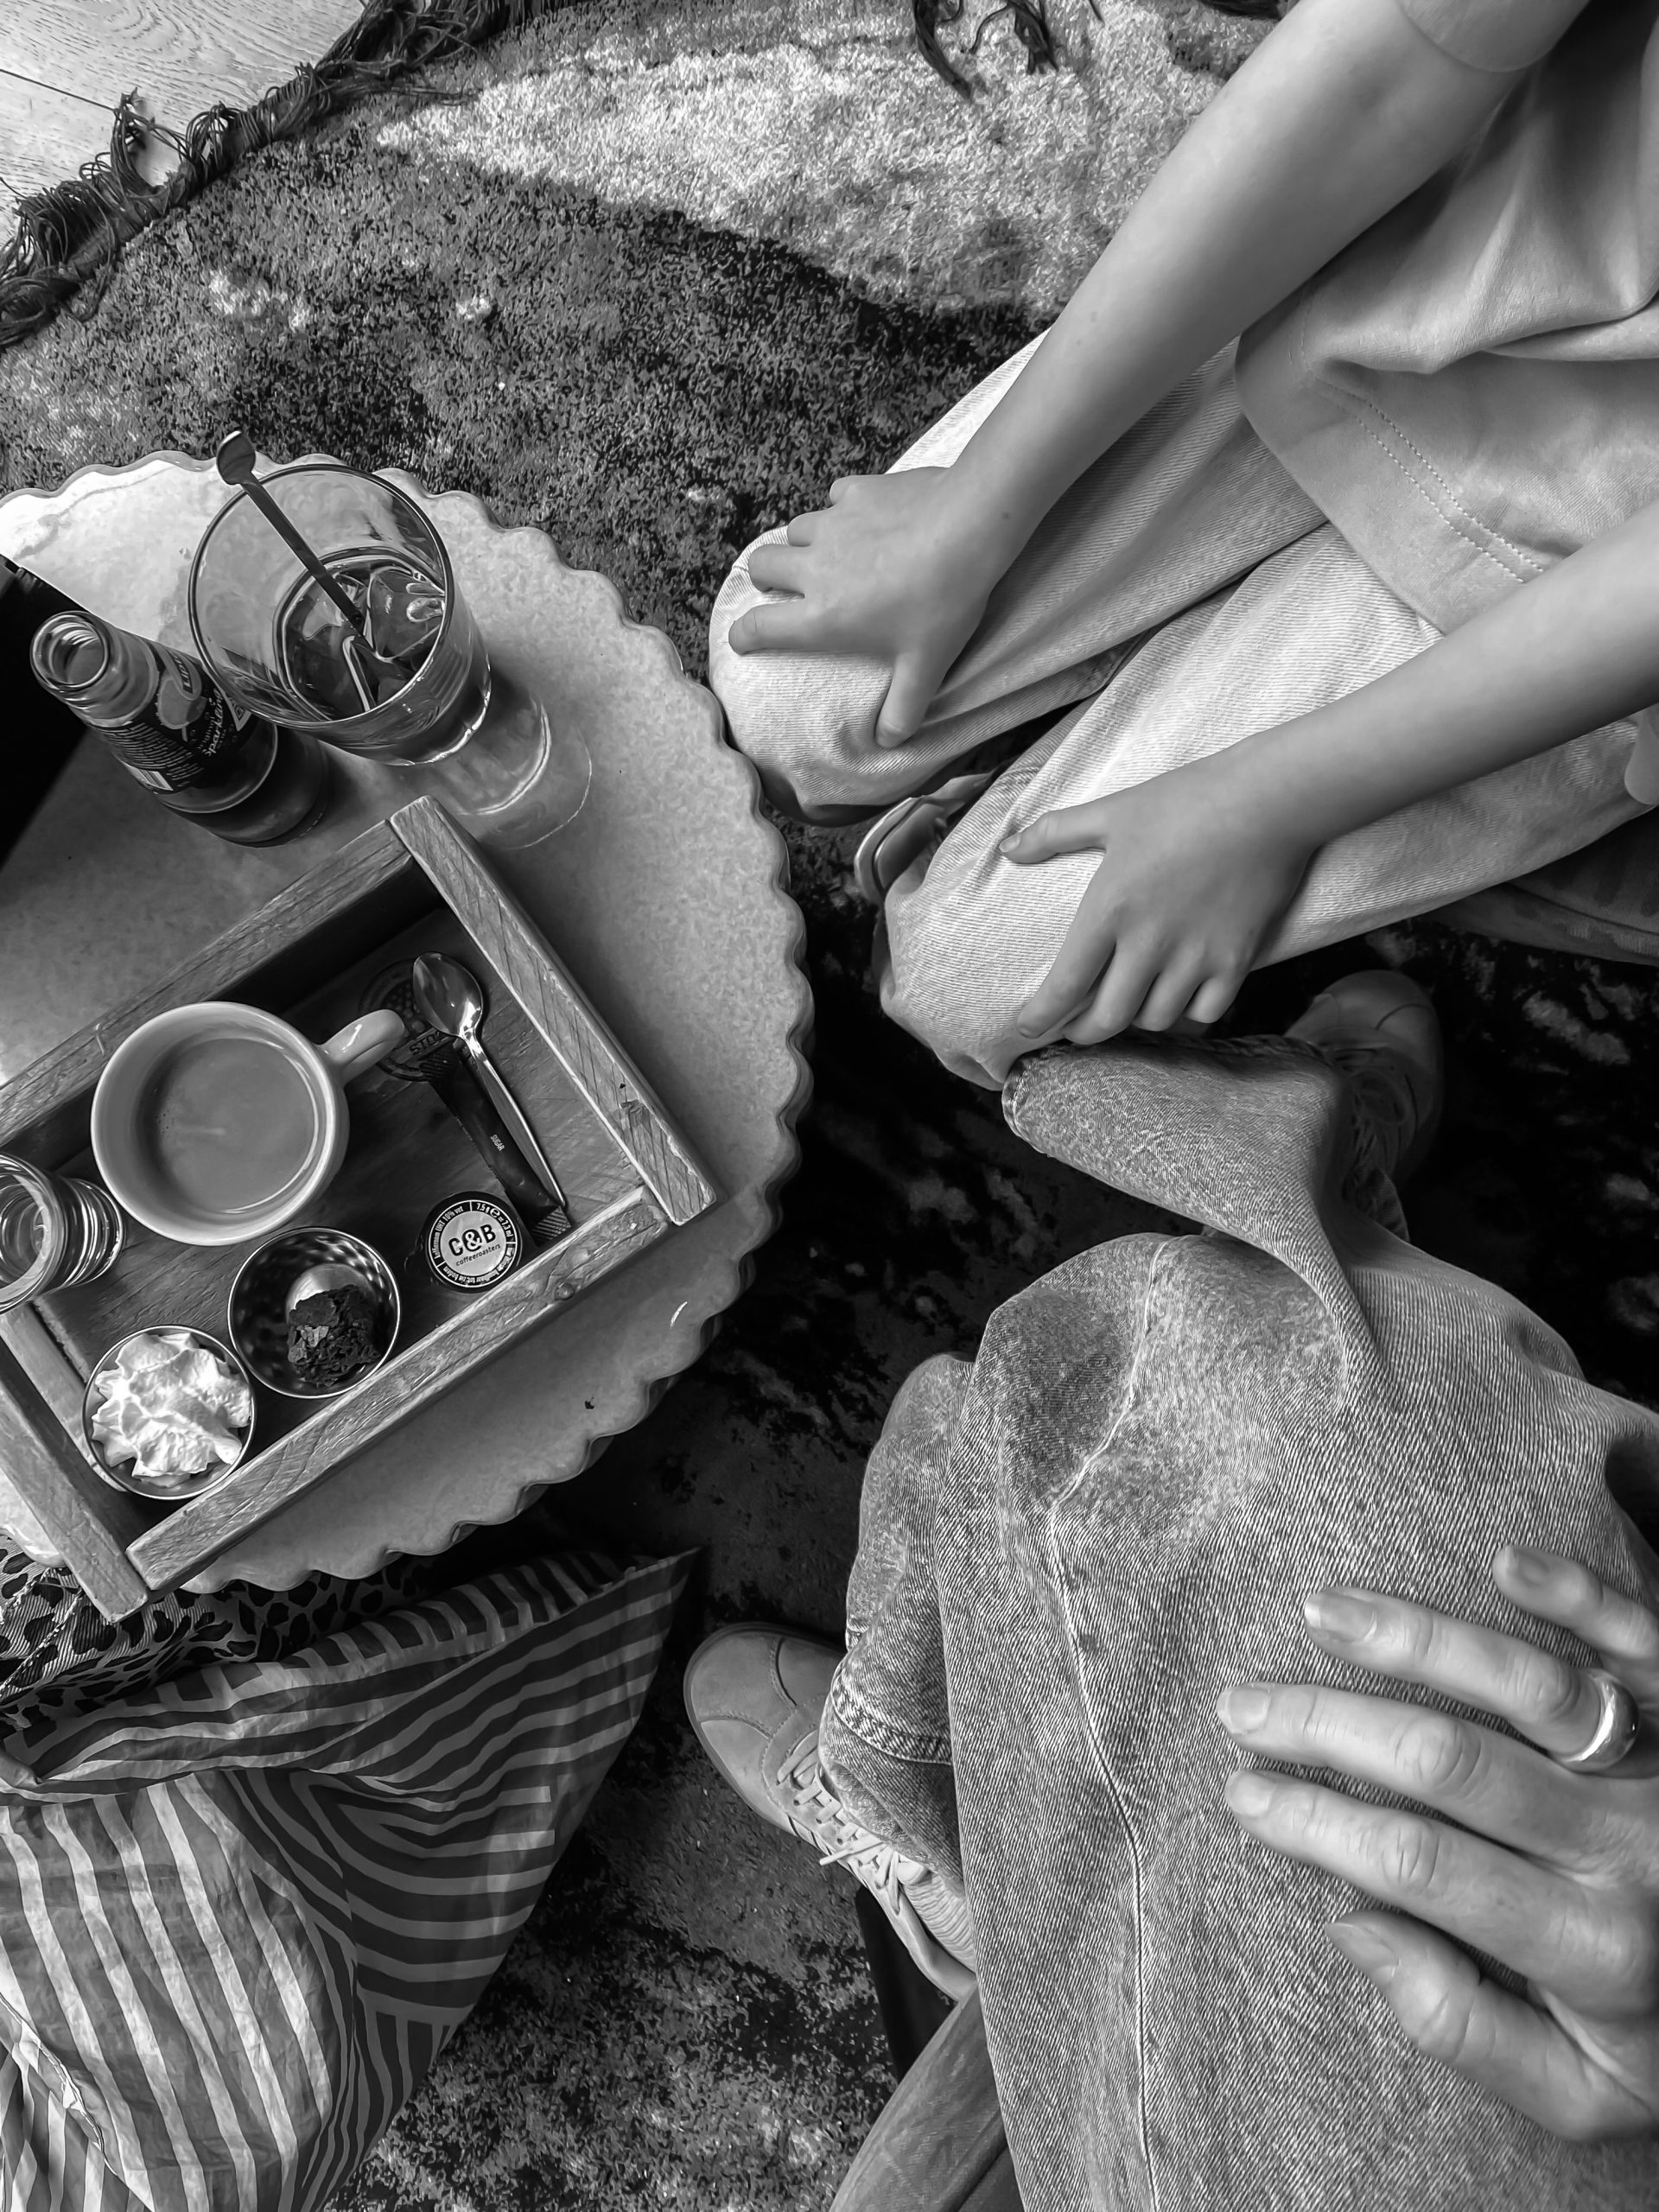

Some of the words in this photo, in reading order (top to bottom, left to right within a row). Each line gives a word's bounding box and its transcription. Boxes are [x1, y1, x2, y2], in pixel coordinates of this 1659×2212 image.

[202, 688, 224, 757] Sparkling
[490, 1135, 505, 1151] SUGAR
[435, 1220, 445, 1232] UHT
[442, 1211, 455, 1222] 10%
[502, 1220, 512, 1230] 7,3
[448, 1224, 496, 1256] C&B
[455, 1244, 501, 1267] coffeeroasters
